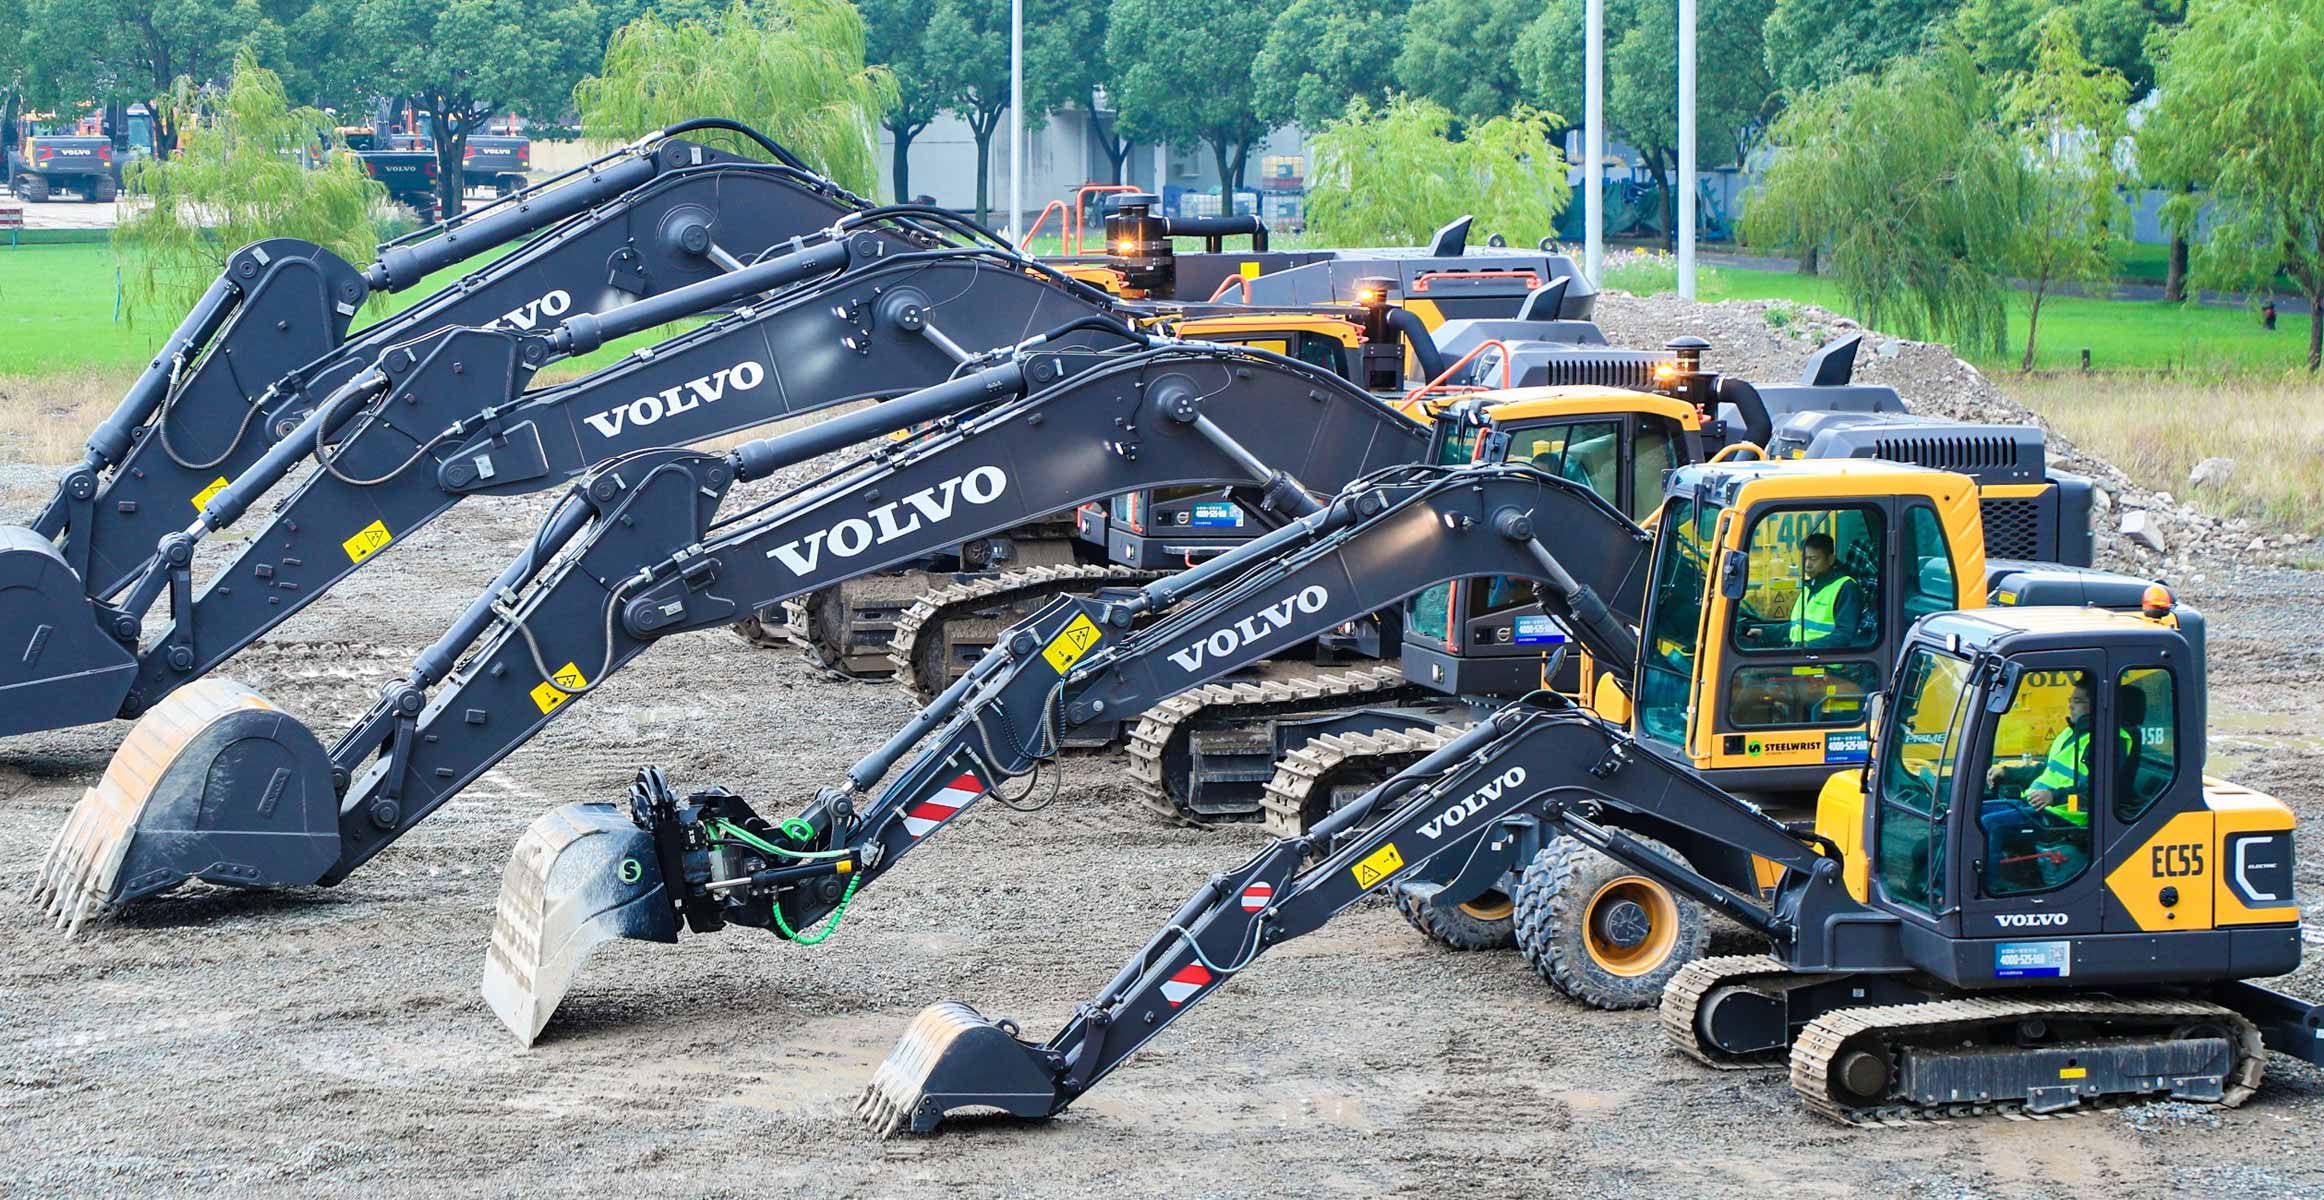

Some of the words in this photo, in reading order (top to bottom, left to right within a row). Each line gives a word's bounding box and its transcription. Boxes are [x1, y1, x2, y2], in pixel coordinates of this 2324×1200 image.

[584, 361, 764, 438] VOLVO
[766, 466, 1007, 576] VOLVO
[1167, 585, 1328, 672] VOLVO
[2027, 671, 2083, 687] OLV
[1764, 742, 1821, 752] STEELWRIST
[1905, 733, 1945, 743] PRIME
[1416, 767, 1526, 839] VOLVO
[2152, 844, 2204, 878] EC55
[1994, 913, 2069, 927] VOLVO
